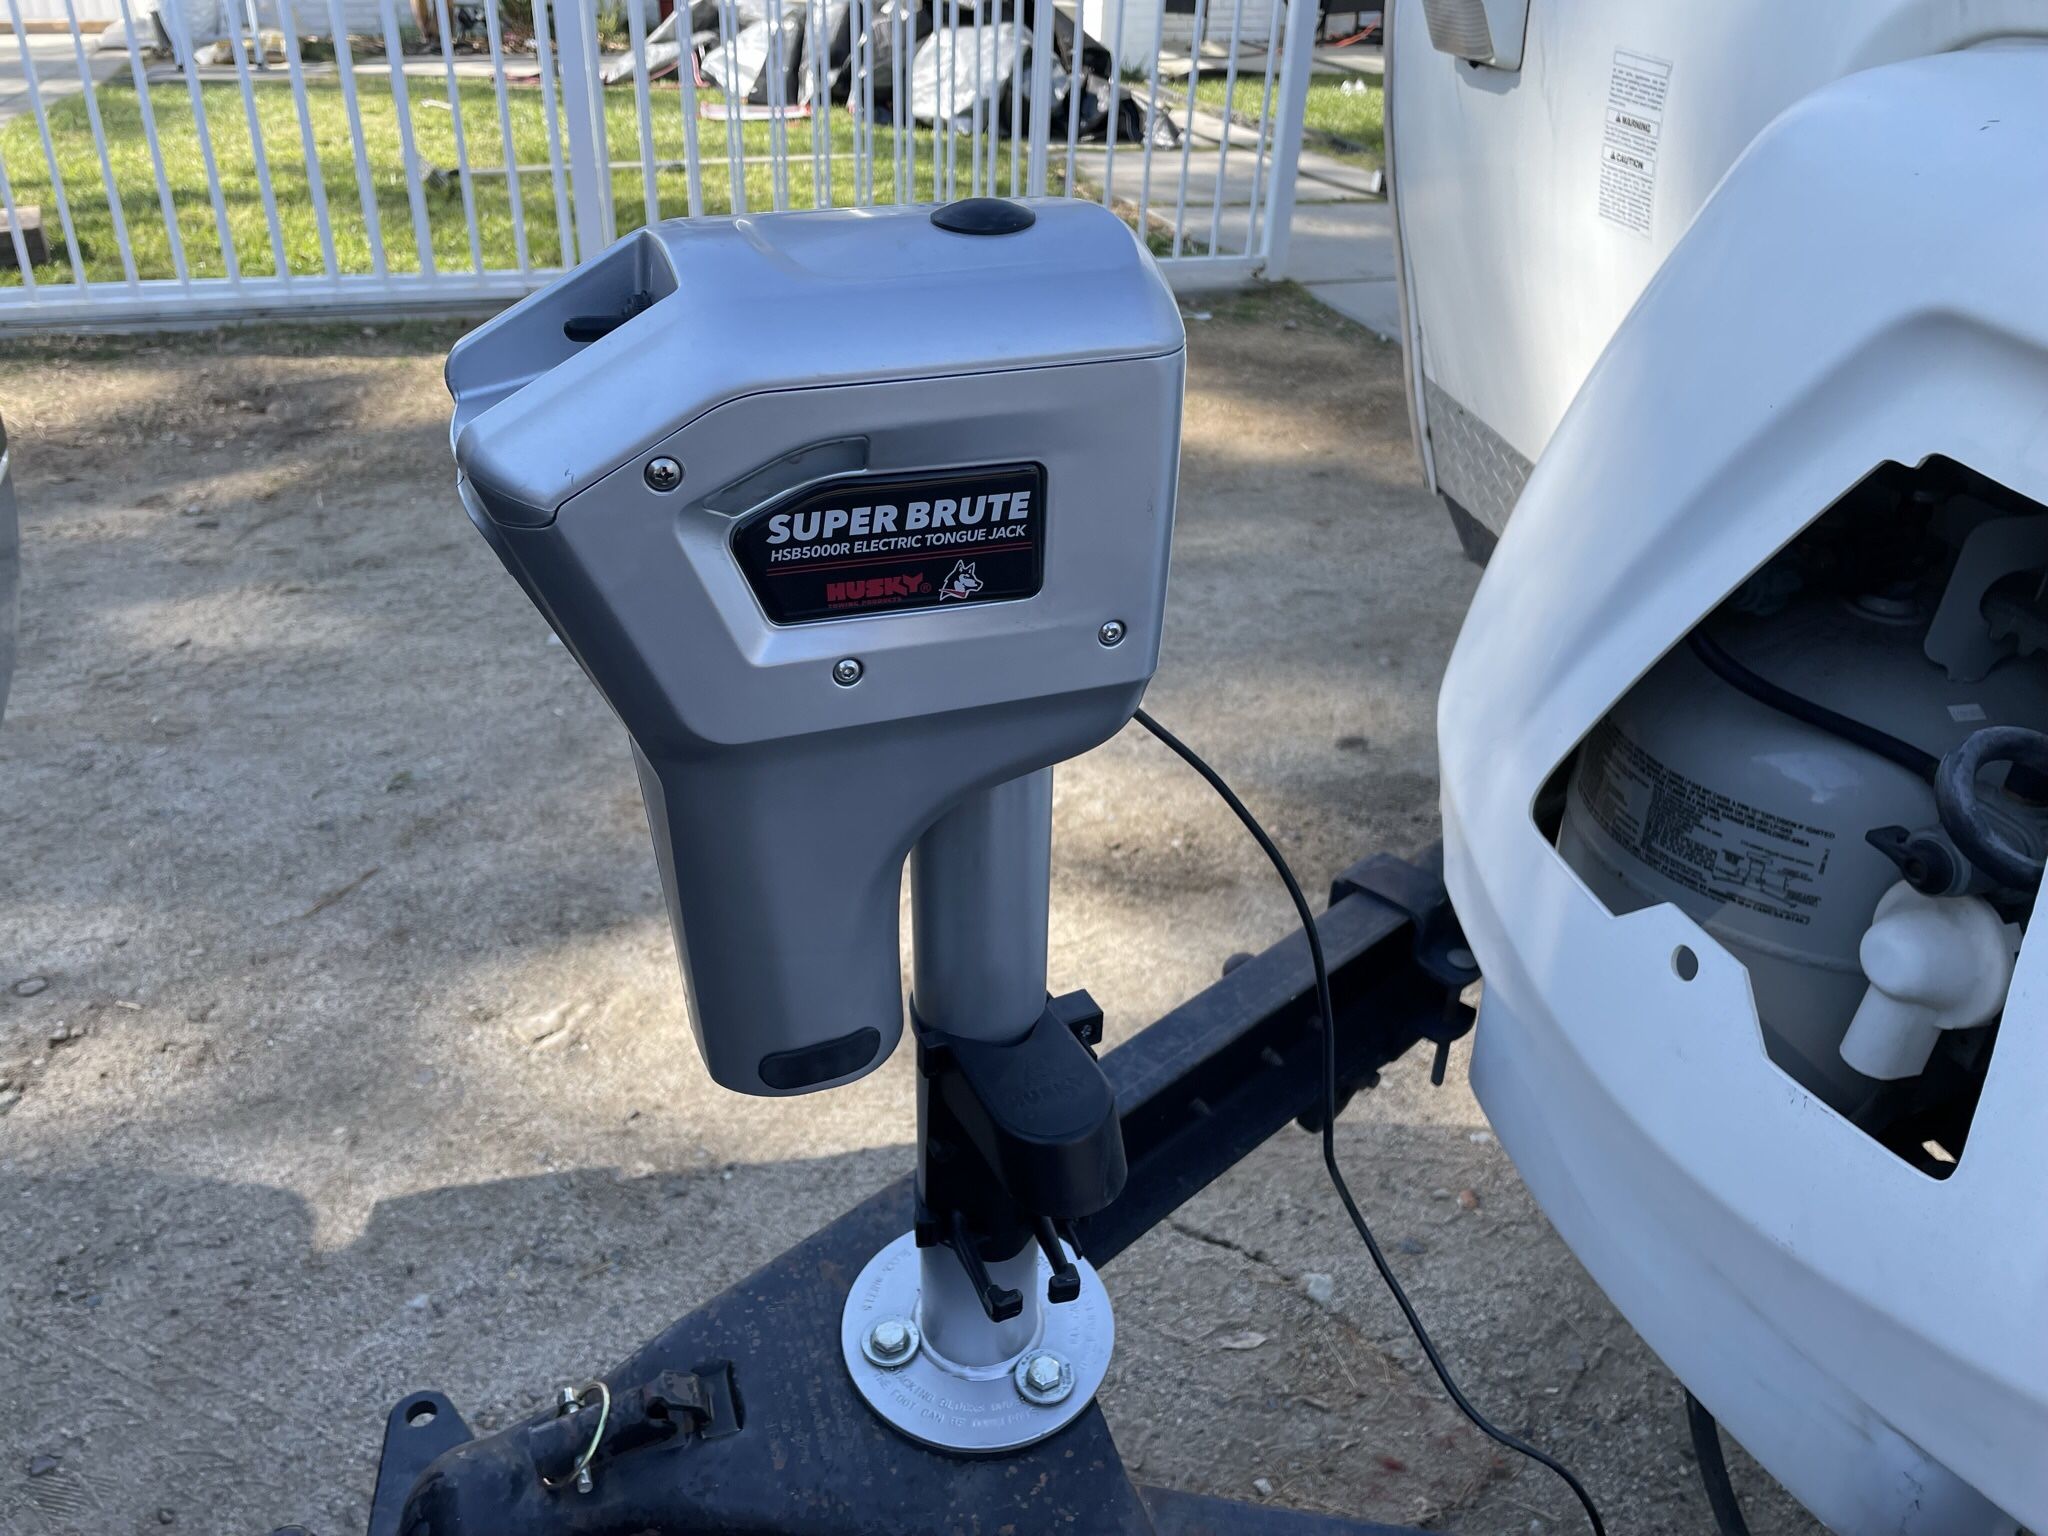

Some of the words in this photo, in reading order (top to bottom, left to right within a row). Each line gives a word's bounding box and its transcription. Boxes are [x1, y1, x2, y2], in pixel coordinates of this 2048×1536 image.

[1622, 116, 1651, 134] WARNING
[1616, 152, 1644, 170] CAUTION
[766, 504, 898, 544] SUPER
[905, 491, 1031, 531] BRUTE
[770, 542, 850, 562] HSB5000R
[853, 535, 922, 554] ELECTRIC
[925, 530, 986, 548] TONGUE
[988, 524, 1026, 540] JACK
[826, 572, 923, 602] HUSKY
